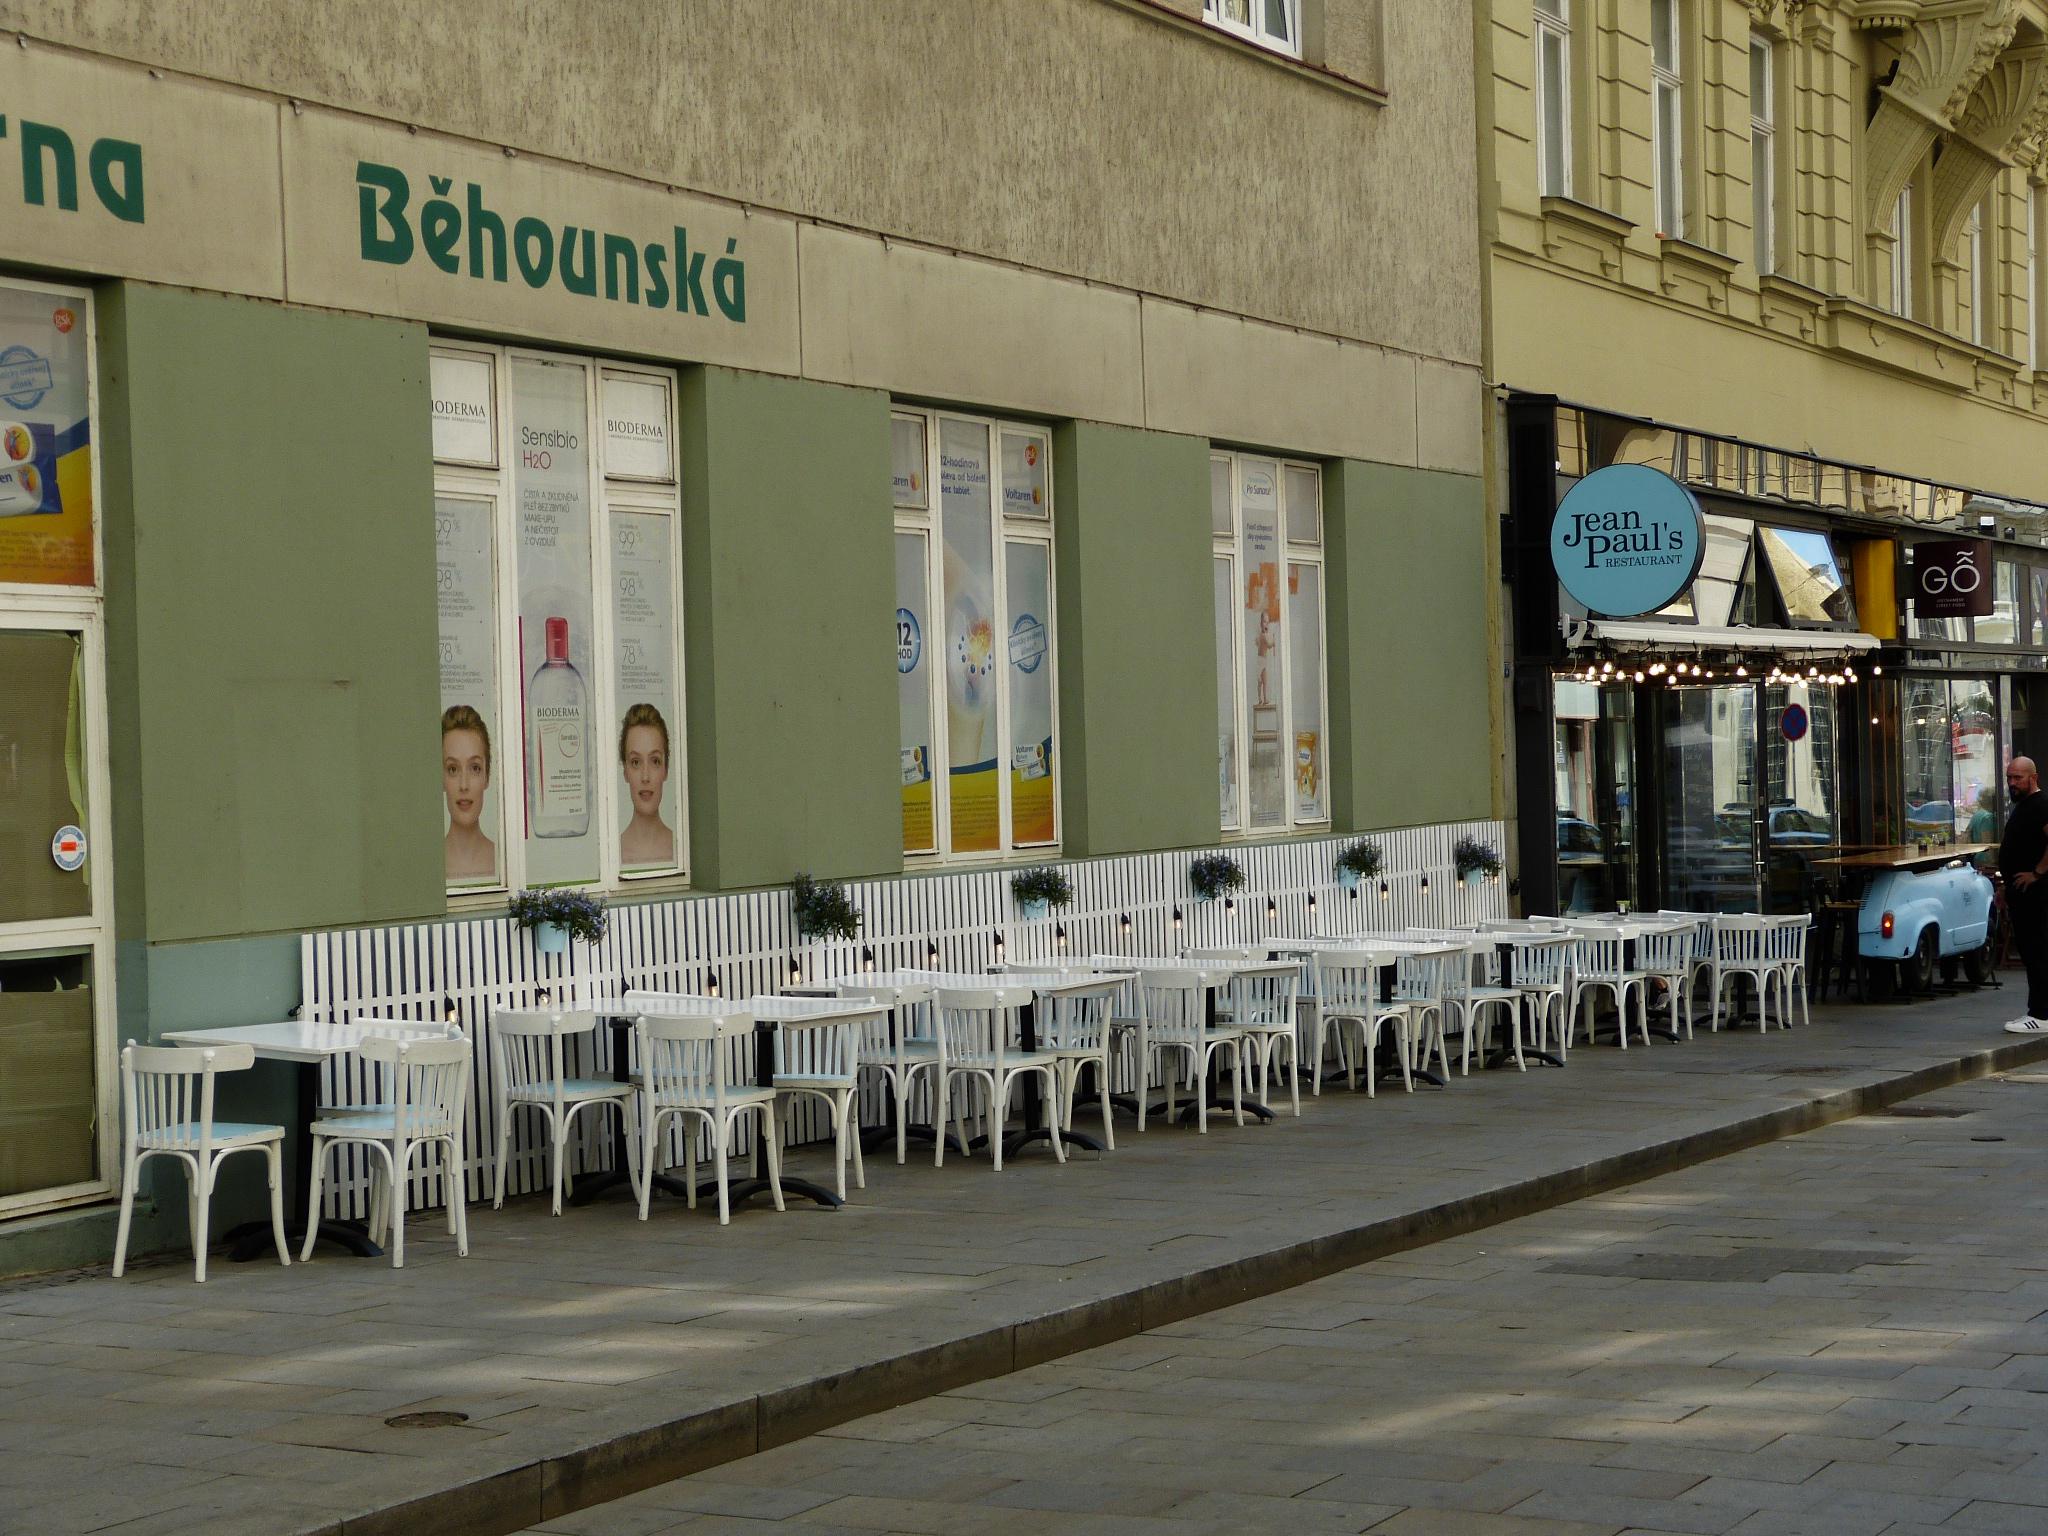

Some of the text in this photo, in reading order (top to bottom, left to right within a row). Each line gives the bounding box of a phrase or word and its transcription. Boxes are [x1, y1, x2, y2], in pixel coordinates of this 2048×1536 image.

[0, 114, 145, 224] na
[356, 161, 746, 323] Běhounská
[521, 426, 578, 450] Sensibio
[607, 419, 663, 438] BIODERMA
[523, 449, 552, 470] H2O
[1005, 487, 1031, 502] Voltaren
[1563, 510, 1642, 548] Jean
[1584, 522, 1683, 569] Paul's
[1605, 554, 1683, 568] RESTAURANT
[896, 622, 912, 646] 12
[537, 707, 580, 718] BIODERMA
